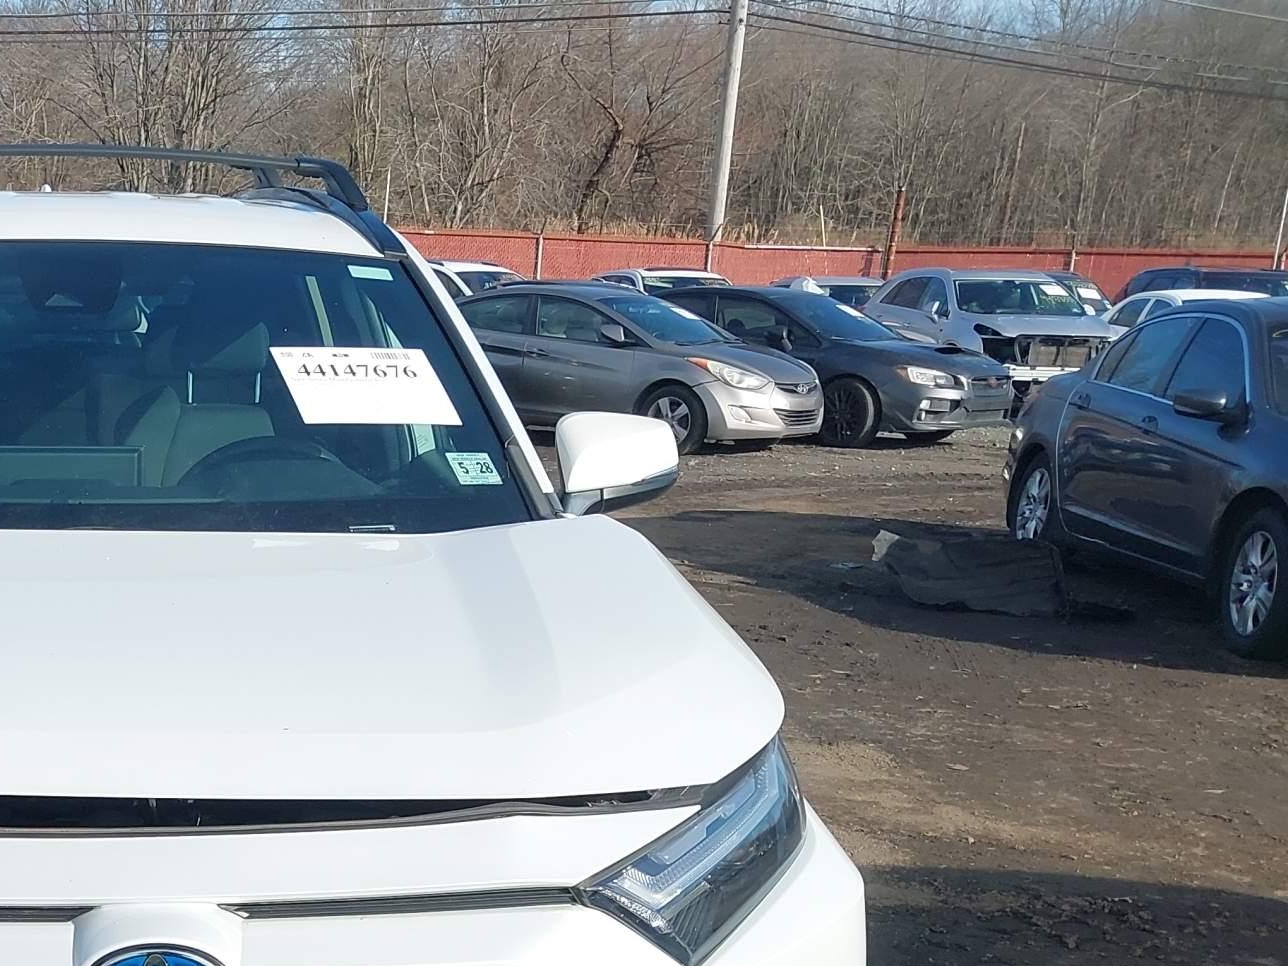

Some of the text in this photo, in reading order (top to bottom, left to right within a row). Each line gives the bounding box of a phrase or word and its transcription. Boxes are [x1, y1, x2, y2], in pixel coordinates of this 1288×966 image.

[297, 363, 418, 378] 44147676
[457, 461, 494, 474] 5 28
